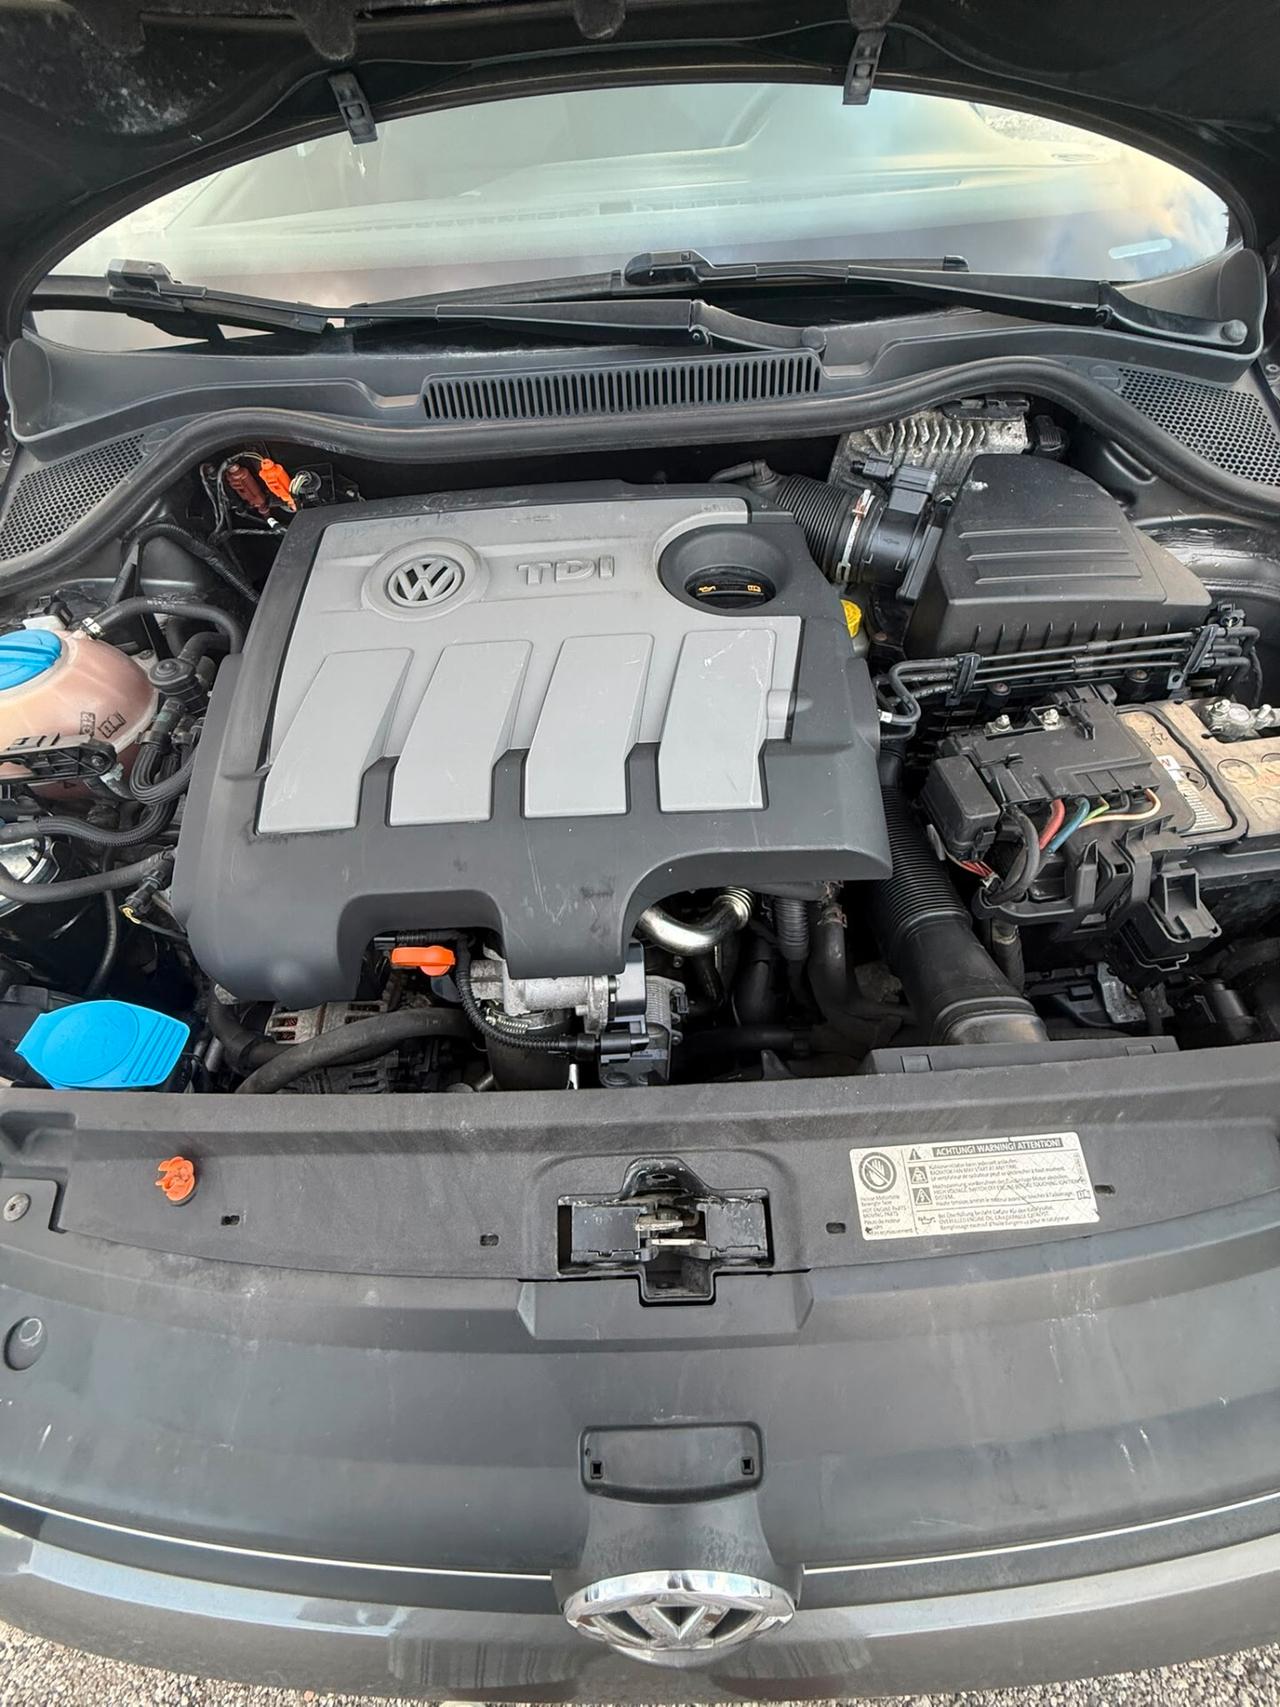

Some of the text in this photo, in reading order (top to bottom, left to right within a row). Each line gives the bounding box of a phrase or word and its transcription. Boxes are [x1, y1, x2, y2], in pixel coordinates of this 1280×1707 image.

[517, 555, 615, 585] TDI
[936, 1138, 1061, 1156] ACHTUNG! WARNING! ATTENTION!
